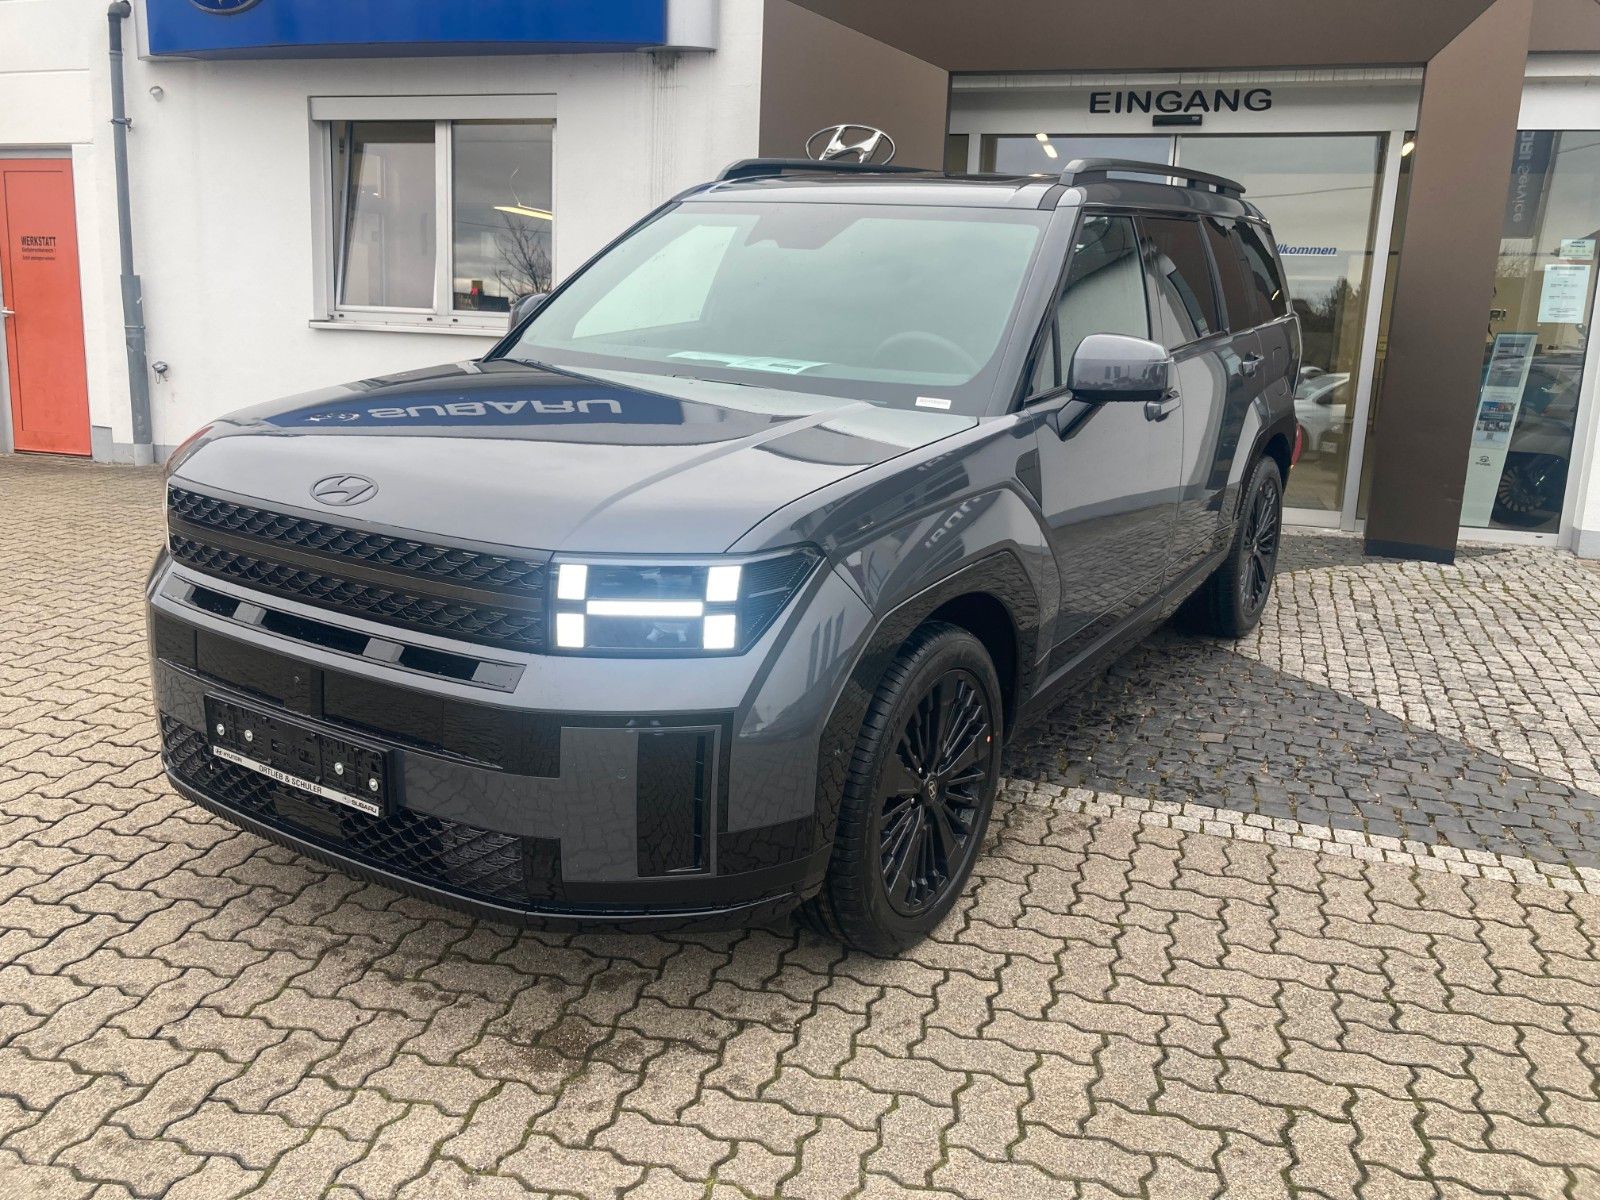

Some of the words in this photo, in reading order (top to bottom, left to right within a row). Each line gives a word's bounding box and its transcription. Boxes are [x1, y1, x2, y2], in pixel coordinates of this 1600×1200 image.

[1089, 88, 1272, 114] EINGANG
[21, 236, 56, 247] WERKSTATT
[259, 764, 284, 780] ORTLIEB
[284, 775, 290, 783] &
[351, 799, 377, 814] SUBARU
